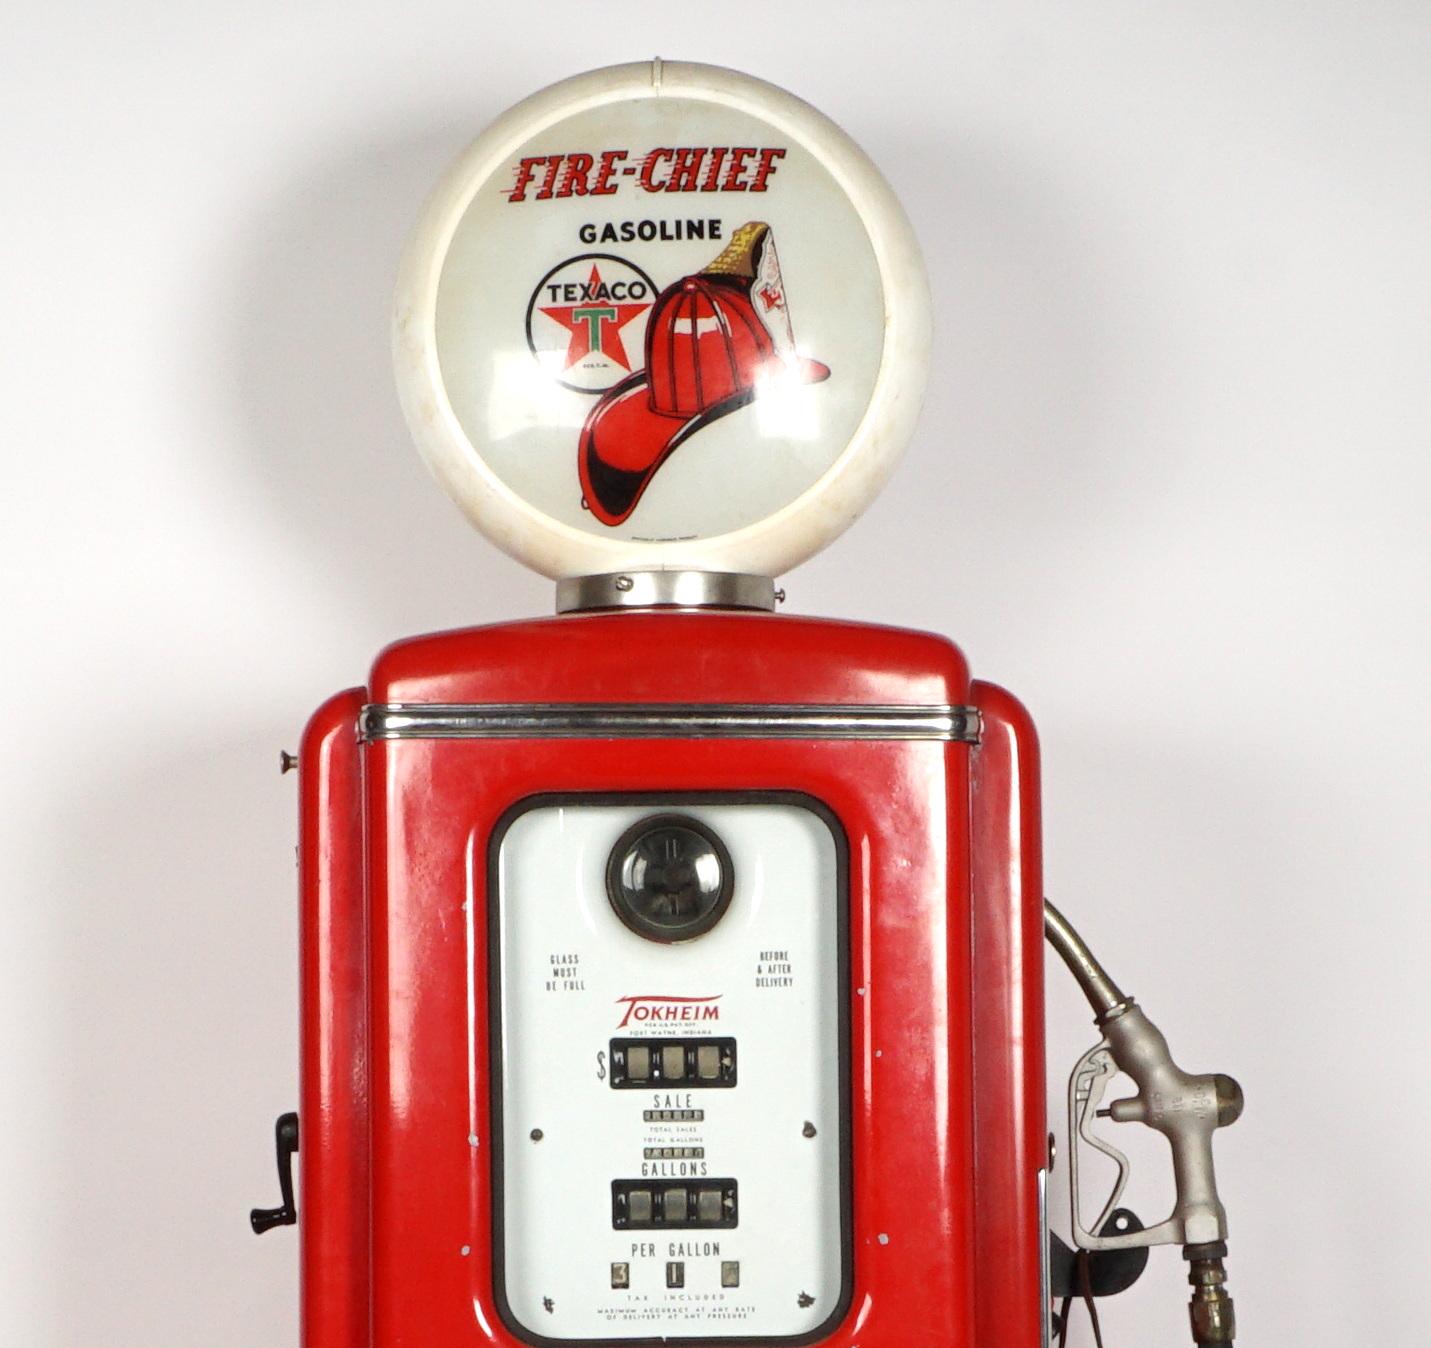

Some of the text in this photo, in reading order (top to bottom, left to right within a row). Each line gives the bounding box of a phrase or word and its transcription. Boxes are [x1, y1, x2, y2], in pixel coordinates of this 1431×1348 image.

[501, 147, 786, 203] FIRE-CHIEF
[579, 219, 722, 244] GASOLINE
[547, 281, 646, 302] TEXACO
[572, 308, 618, 354] T
[550, 954, 579, 965] GLASS
[760, 951, 788, 961] BEFORE
[553, 967, 577, 978] MUST
[768, 964, 791, 974] AFTER
[546, 980, 585, 991] BE FULL
[756, 977, 793, 987] DELIVERY
[615, 994, 723, 1029] TOKHEIM
[597, 1050, 606, 1080] $
[654, 1094, 692, 1108] SALE
[641, 1162, 708, 1176] GALLONS
[631, 1242, 720, 1257] PER GALLON
[613, 1263, 627, 1284] 3
